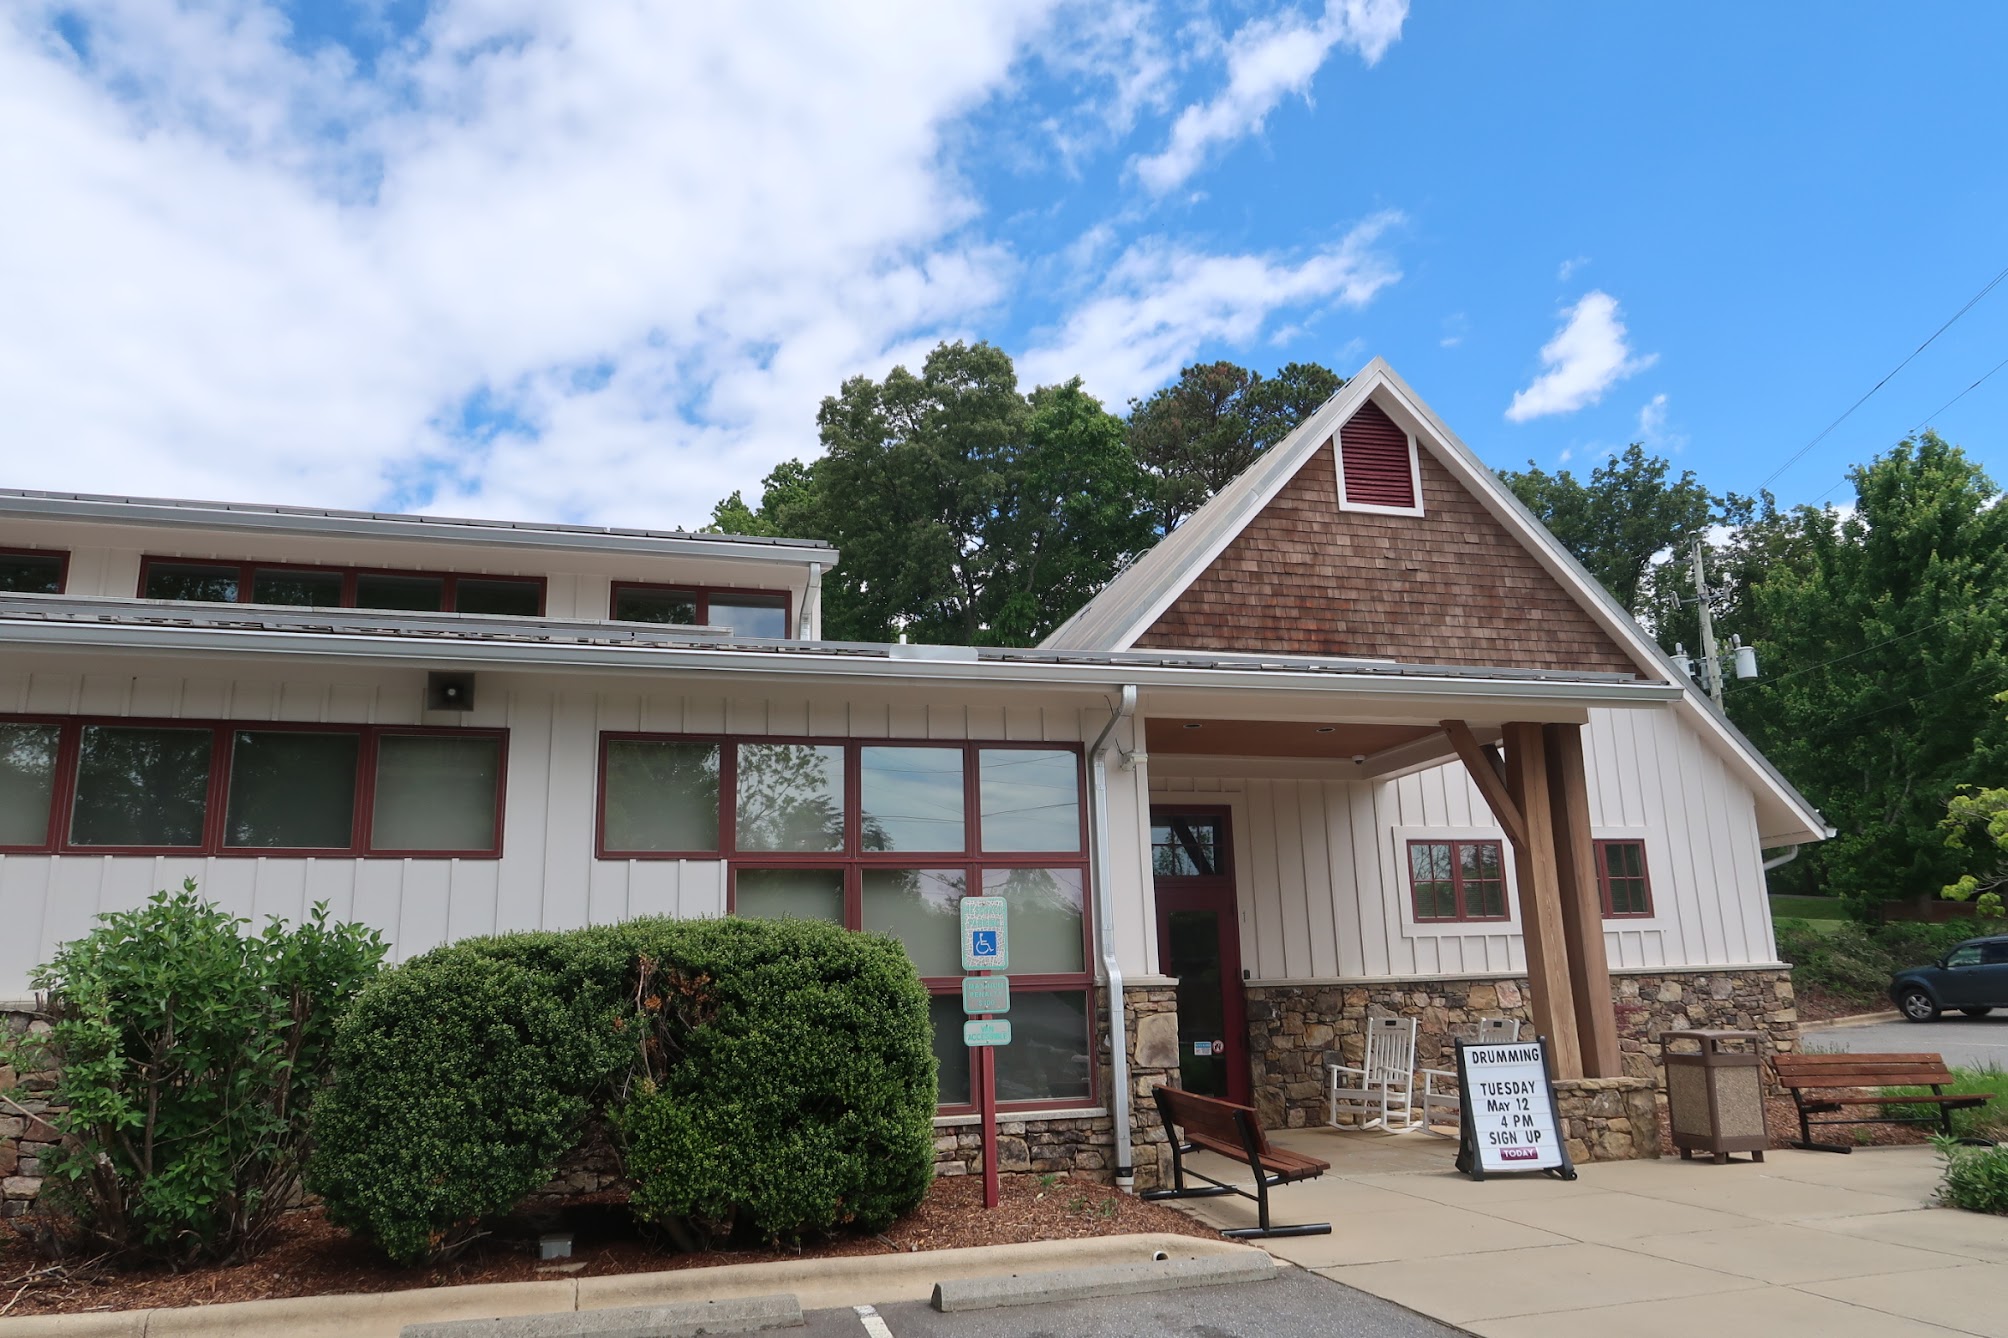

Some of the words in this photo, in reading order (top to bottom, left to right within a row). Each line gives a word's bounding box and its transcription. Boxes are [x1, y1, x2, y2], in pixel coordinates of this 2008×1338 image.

[967, 1032, 1007, 1041] ACCESSIBLE
[1472, 1048, 1539, 1064] DRUMMING
[1480, 1081, 1535, 1096] TUESDAY
[1516, 1098, 1529, 1111] 12
[1501, 1115, 1508, 1128] 4
[1513, 1114, 1534, 1127] PM
[1489, 1131, 1518, 1145] SIGN
[1526, 1130, 1541, 1143] UP
[1503, 1149, 1534, 1158] TODAY
